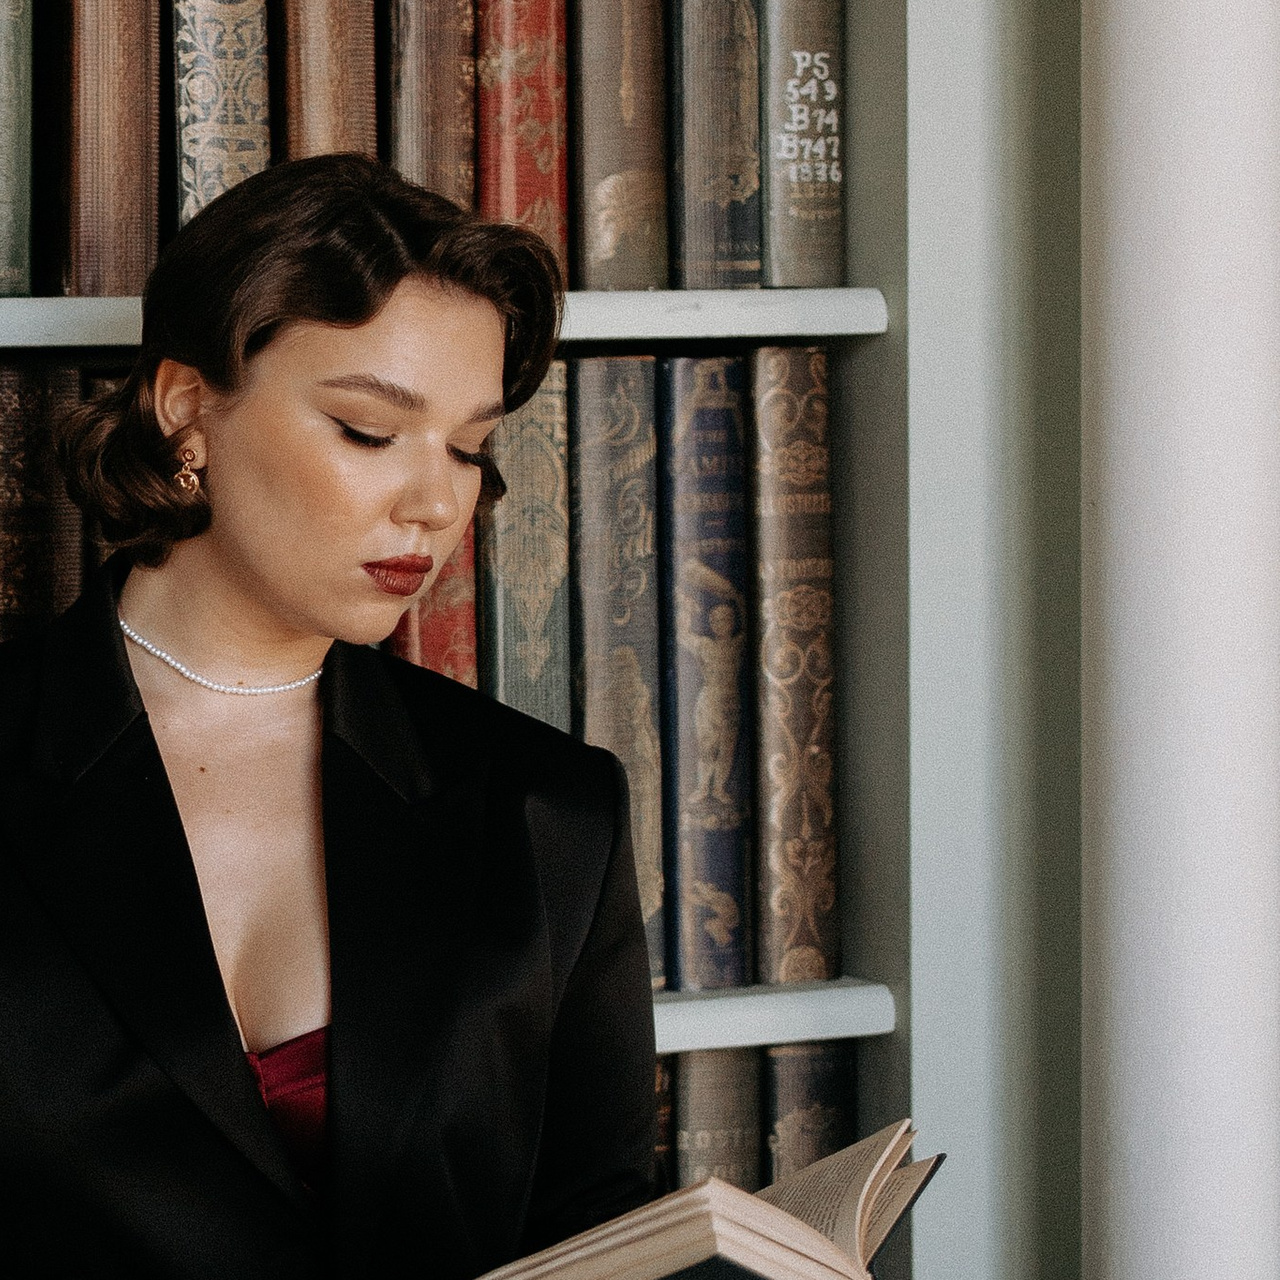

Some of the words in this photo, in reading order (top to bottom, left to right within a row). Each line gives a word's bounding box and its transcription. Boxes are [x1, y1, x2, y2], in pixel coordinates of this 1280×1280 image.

[792, 50, 830, 80] PS
[786, 79, 837, 102] 549
[785, 104, 839, 133] B74
[776, 133, 840, 160] B747
